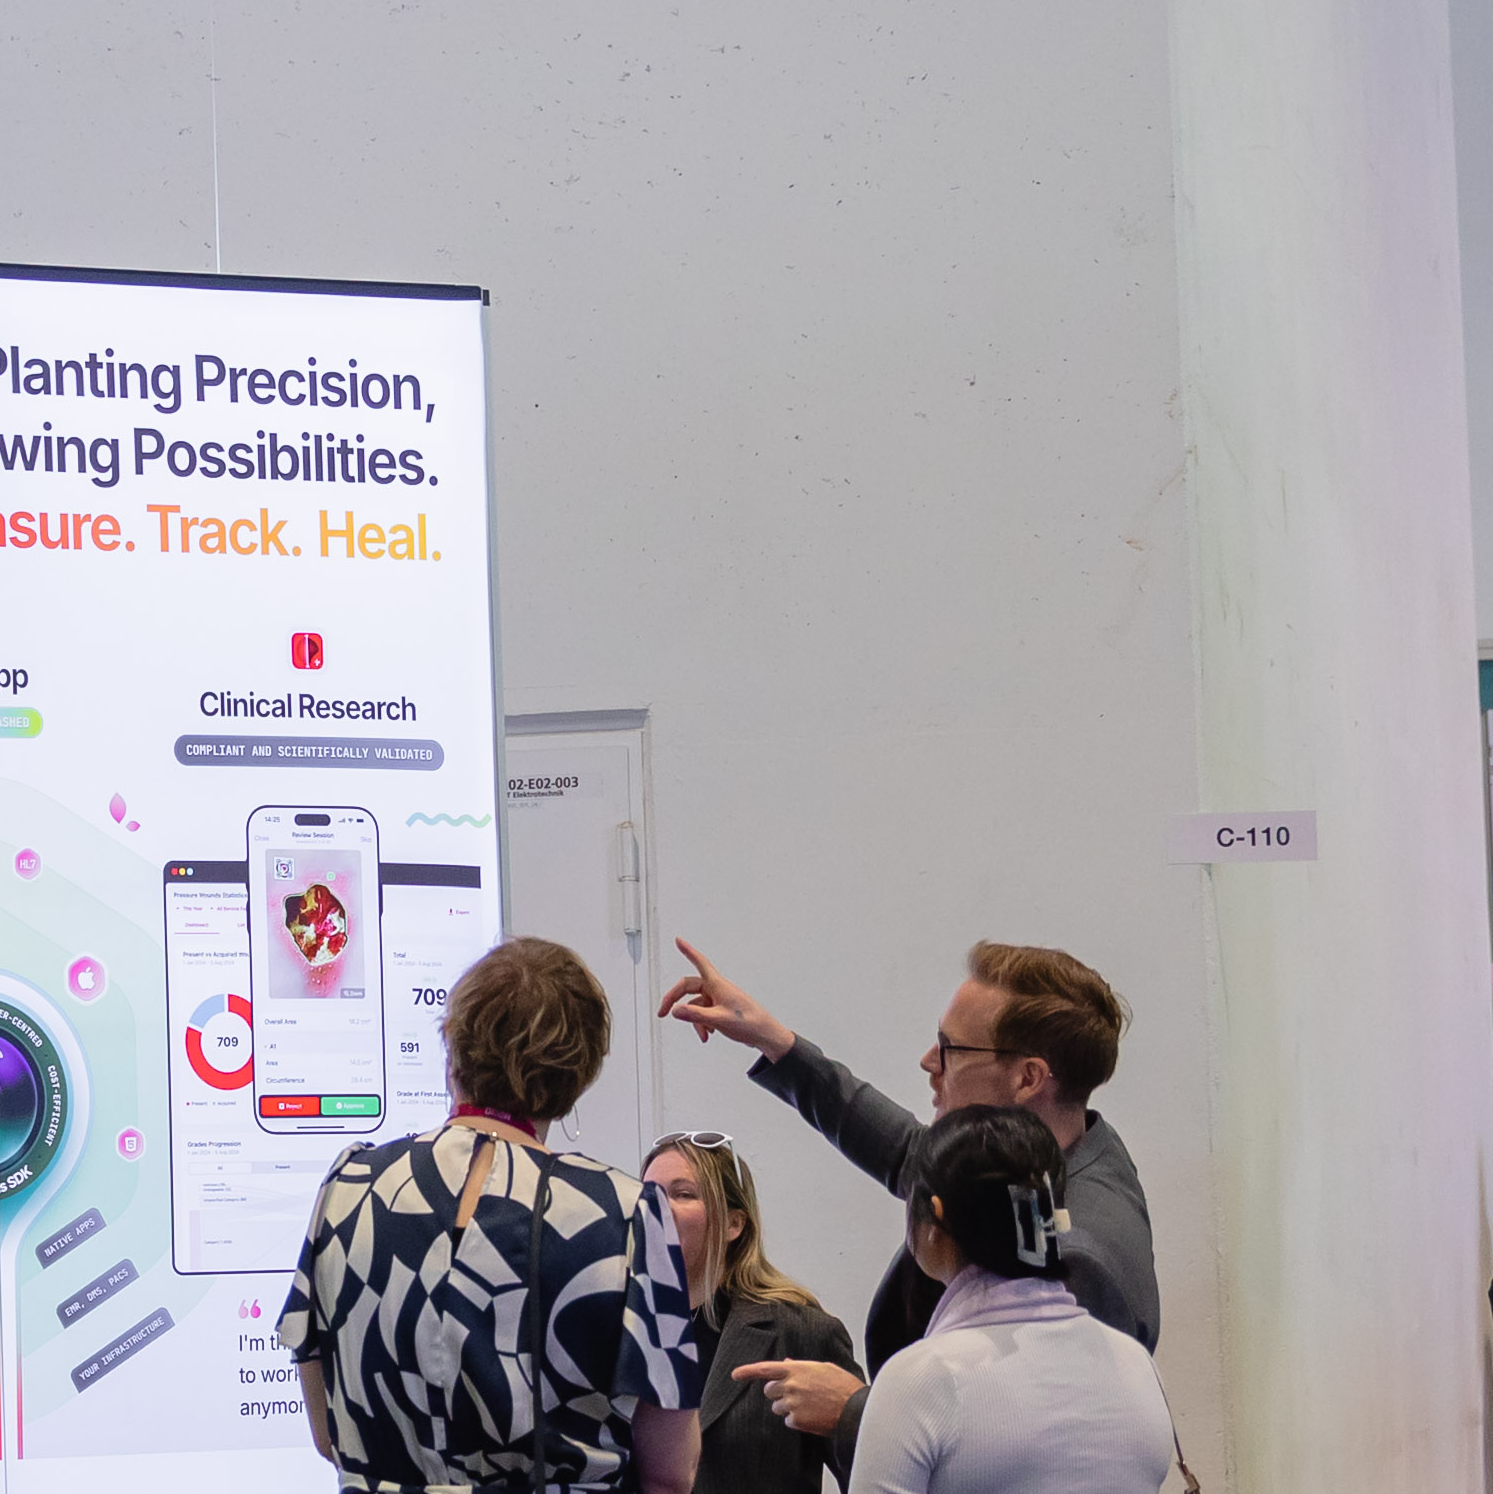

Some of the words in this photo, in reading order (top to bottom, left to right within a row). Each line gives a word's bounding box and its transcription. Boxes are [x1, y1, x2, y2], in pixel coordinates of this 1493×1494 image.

[194, 354, 435, 423] Precision,
[133, 428, 439, 487] Possibilities.
[147, 504, 301, 557] Track.
[319, 509, 442, 561] Heal.
[199, 691, 293, 720] Clinical
[299, 693, 417, 722] Research
[185, 744, 247, 759] COMPLIANT
[251, 745, 272, 758] AND
[276, 745, 370, 761] SCIENTIFICALLY
[374, 747, 434, 762] VALIDATED
[513, 790, 563, 798] Elektrotechnik
[1216, 825, 1291, 850] C-110
[20, 858, 36, 870] HL7
[413, 988, 447, 1006] 709
[217, 1036, 239, 1048] 709
[400, 1043, 419, 1052] 591
[44, 1065, 61, 1146] COST-EFFICIENT
[7, 1164, 33, 1188] SDK
[44, 1232, 73, 1257] NATIVE
[75, 1218, 95, 1235] APPS
[65, 1301, 85, 1317] EMR,
[108, 1269, 129, 1286] PACS
[79, 1362, 100, 1380] YOUR
[101, 1316, 165, 1365] INFRASTRUCTURE
[240, 1335, 264, 1351] I'm
[239, 1368, 255, 1383] to
